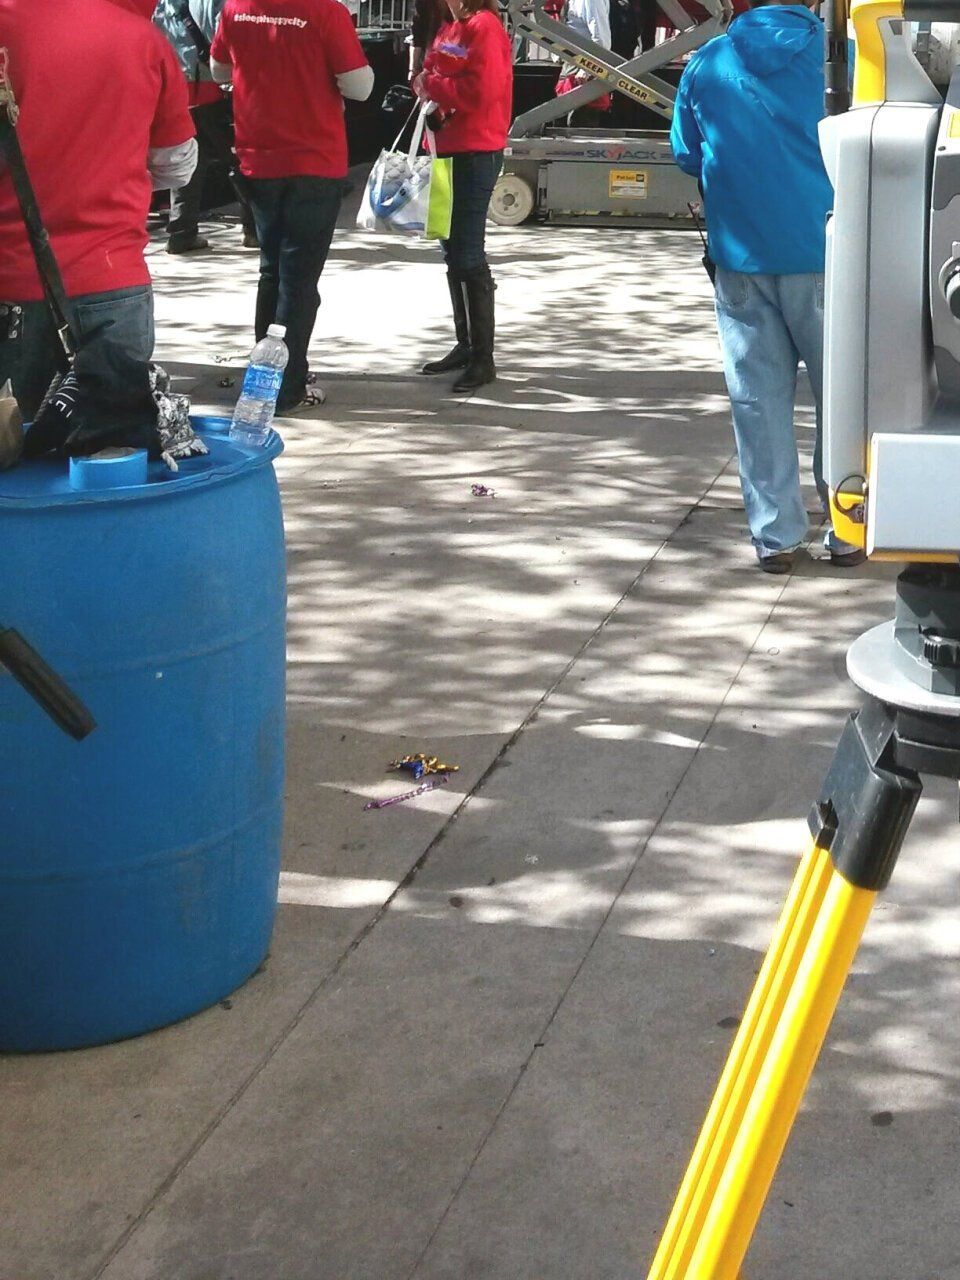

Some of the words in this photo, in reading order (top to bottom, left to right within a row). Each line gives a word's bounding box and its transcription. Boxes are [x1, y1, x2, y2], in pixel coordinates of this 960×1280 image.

[579, 57, 605, 75] KEEP
[617, 79, 649, 101] CLEAR
[586, 144, 657, 161] SKYJACK
